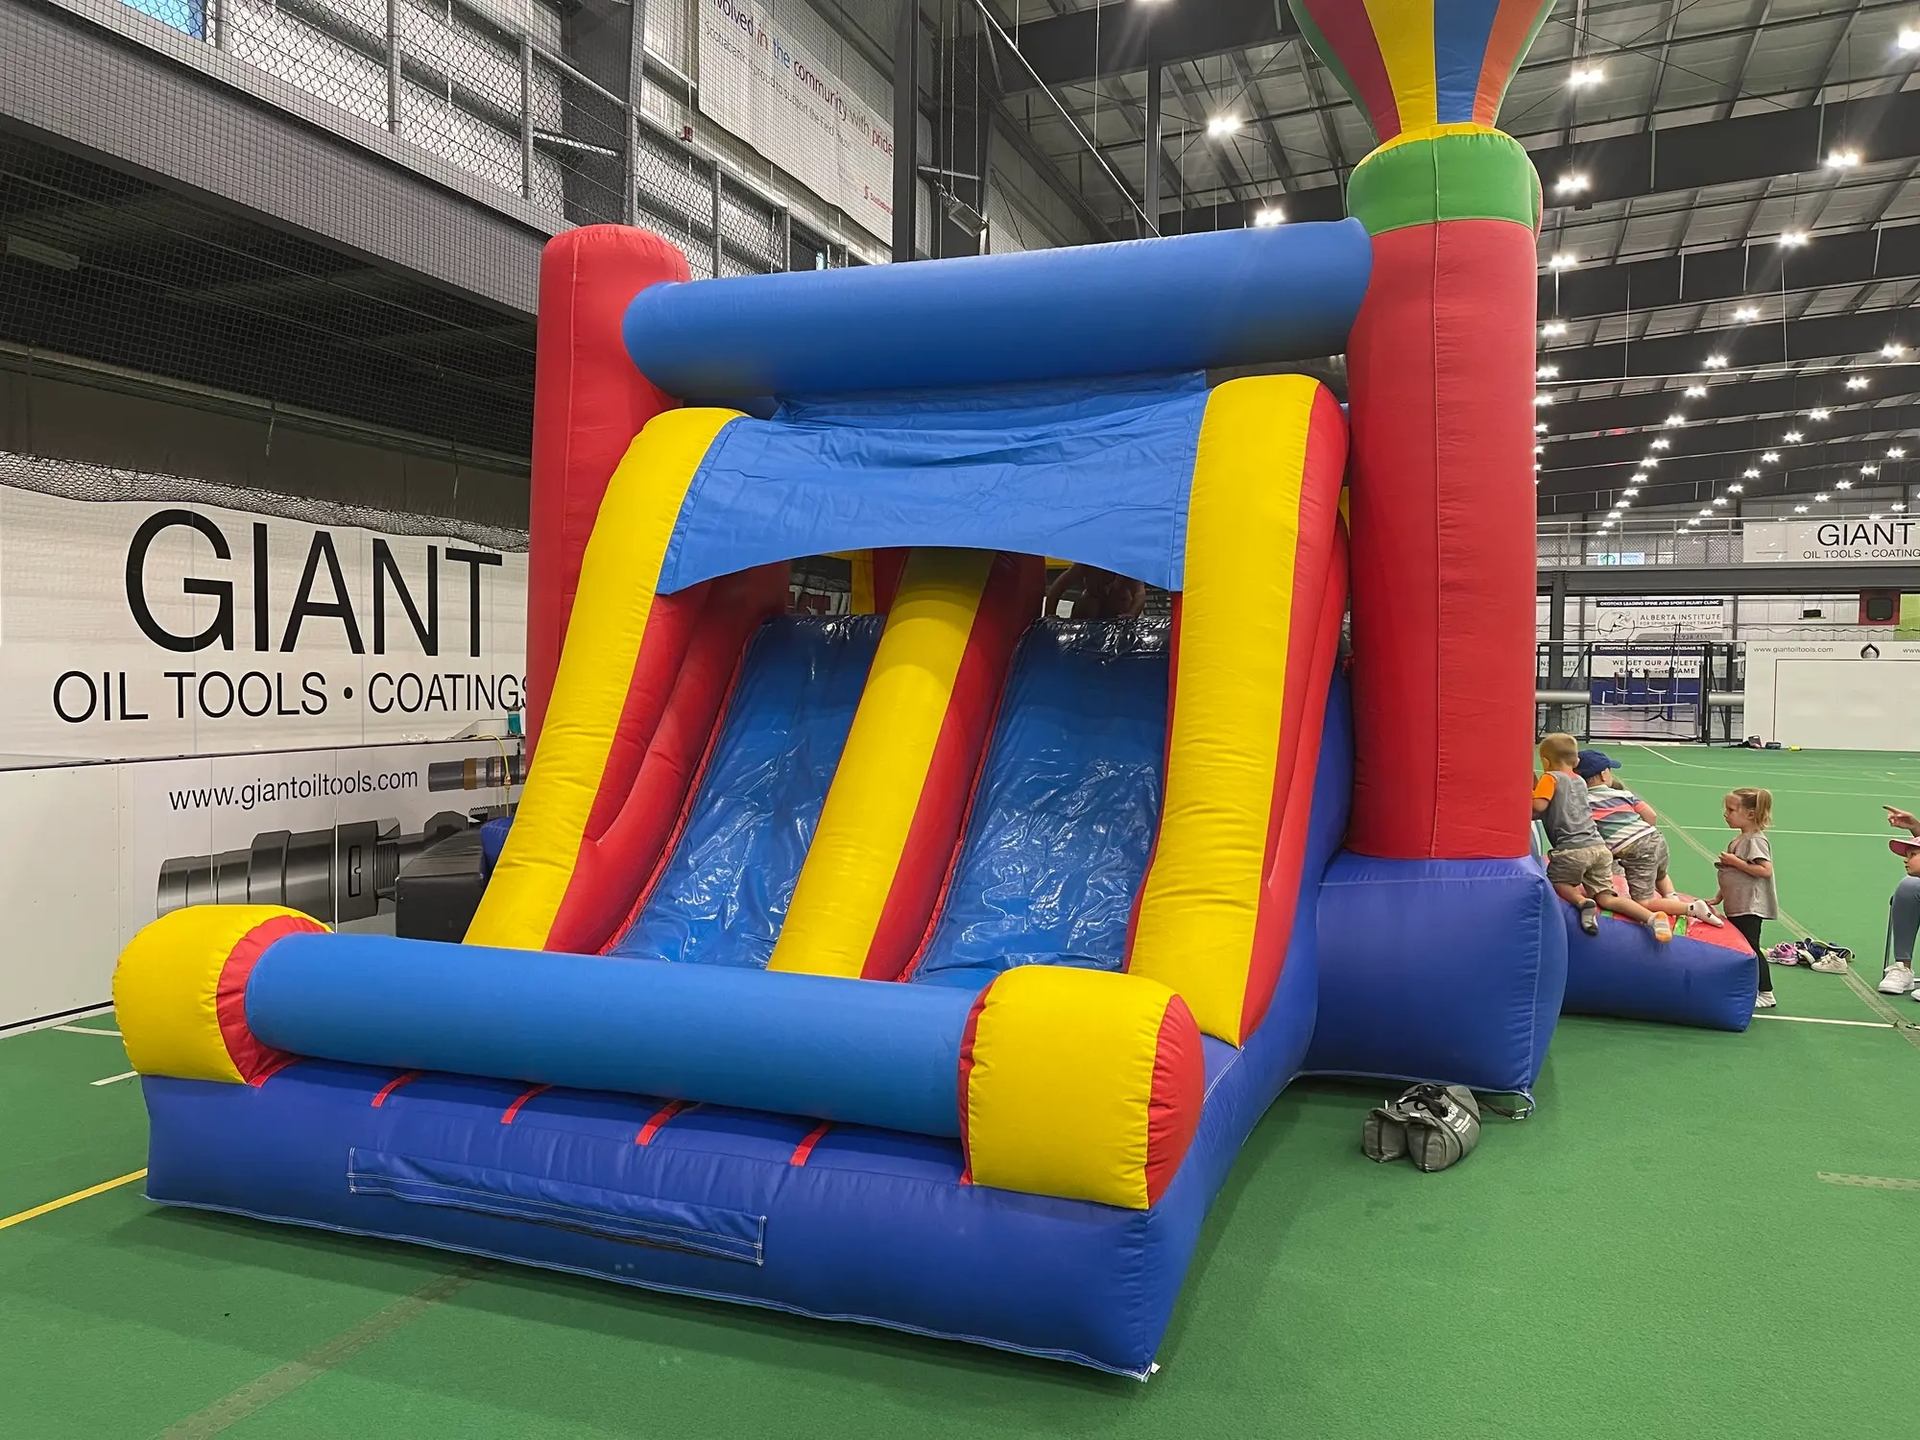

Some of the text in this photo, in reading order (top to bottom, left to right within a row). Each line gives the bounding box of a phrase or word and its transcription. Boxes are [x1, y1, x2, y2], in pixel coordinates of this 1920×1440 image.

[713, 0, 754, 37] volved
[756, 23, 769, 51] in
[772, 37, 791, 69] the
[794, 61, 847, 121] community
[849, 109, 870, 137] with
[872, 129, 893, 158] pride
[1803, 550, 1820, 559] OIL
[1824, 549, 1862, 559] TOOLS
[1817, 522, 1916, 546] GIANT
[125, 509, 503, 658] GIANT
[1753, 645, 1834, 653] www.giantoiltools.com
[53, 671, 148, 723] OIL
[163, 671, 328, 718] TOOLS
[169, 770, 418, 812] www.giantoiltools.com
